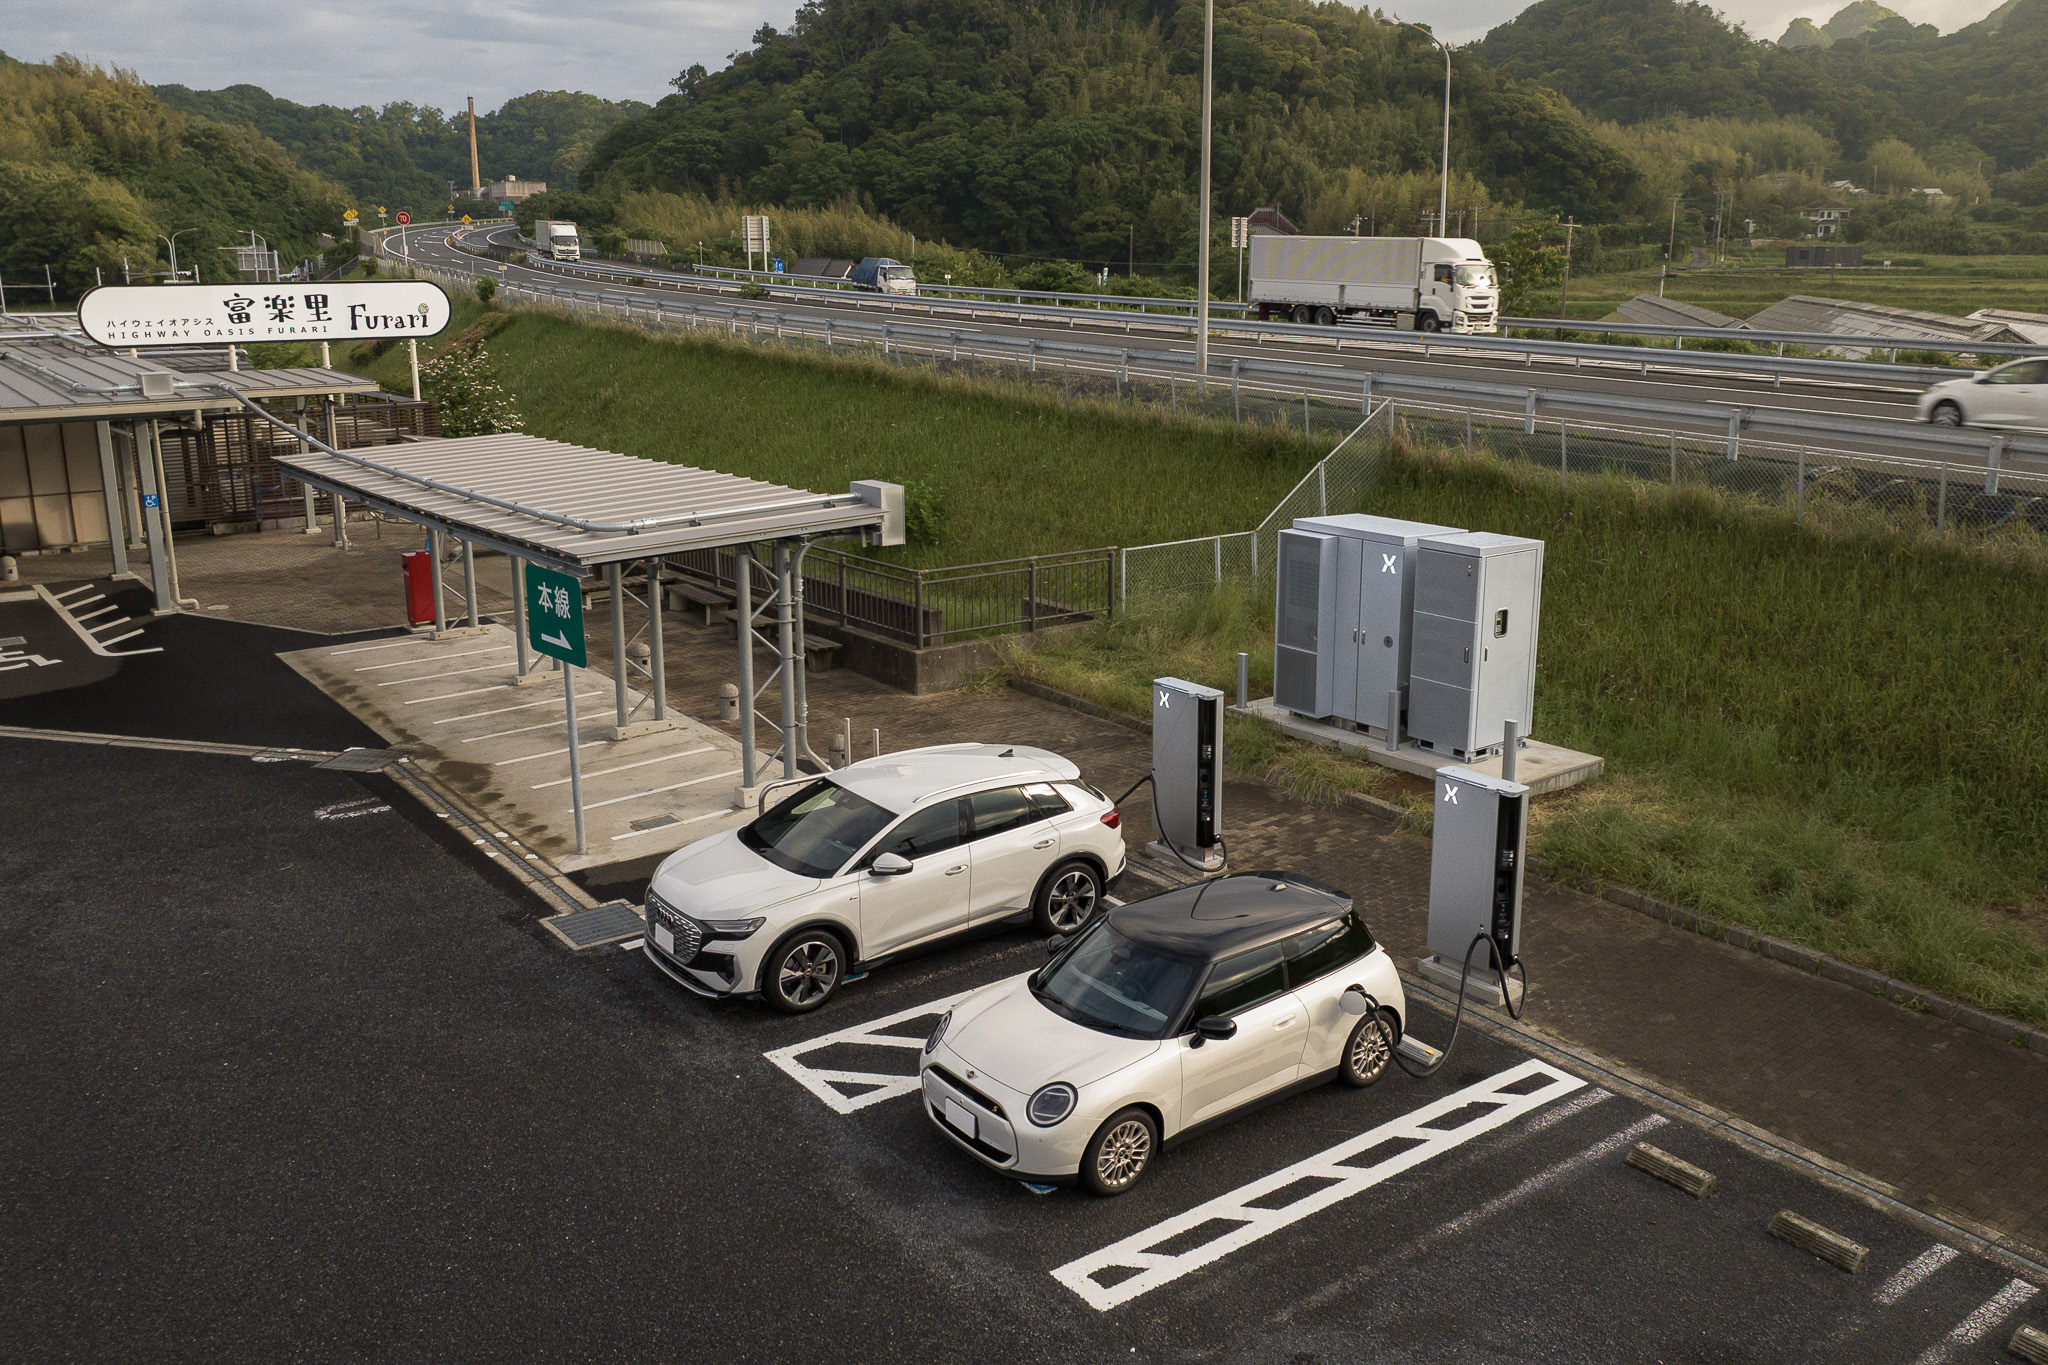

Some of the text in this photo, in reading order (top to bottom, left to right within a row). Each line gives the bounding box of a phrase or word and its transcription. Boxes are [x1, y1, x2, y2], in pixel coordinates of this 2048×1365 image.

[223, 293, 332, 324] 富楽里
[347, 303, 429, 330] Furari
[107, 318, 214, 328] ハイウェイオアシス
[108, 325, 327, 339] HIGHWAY OASIS FURARI
[537, 581, 571, 619] 本線
